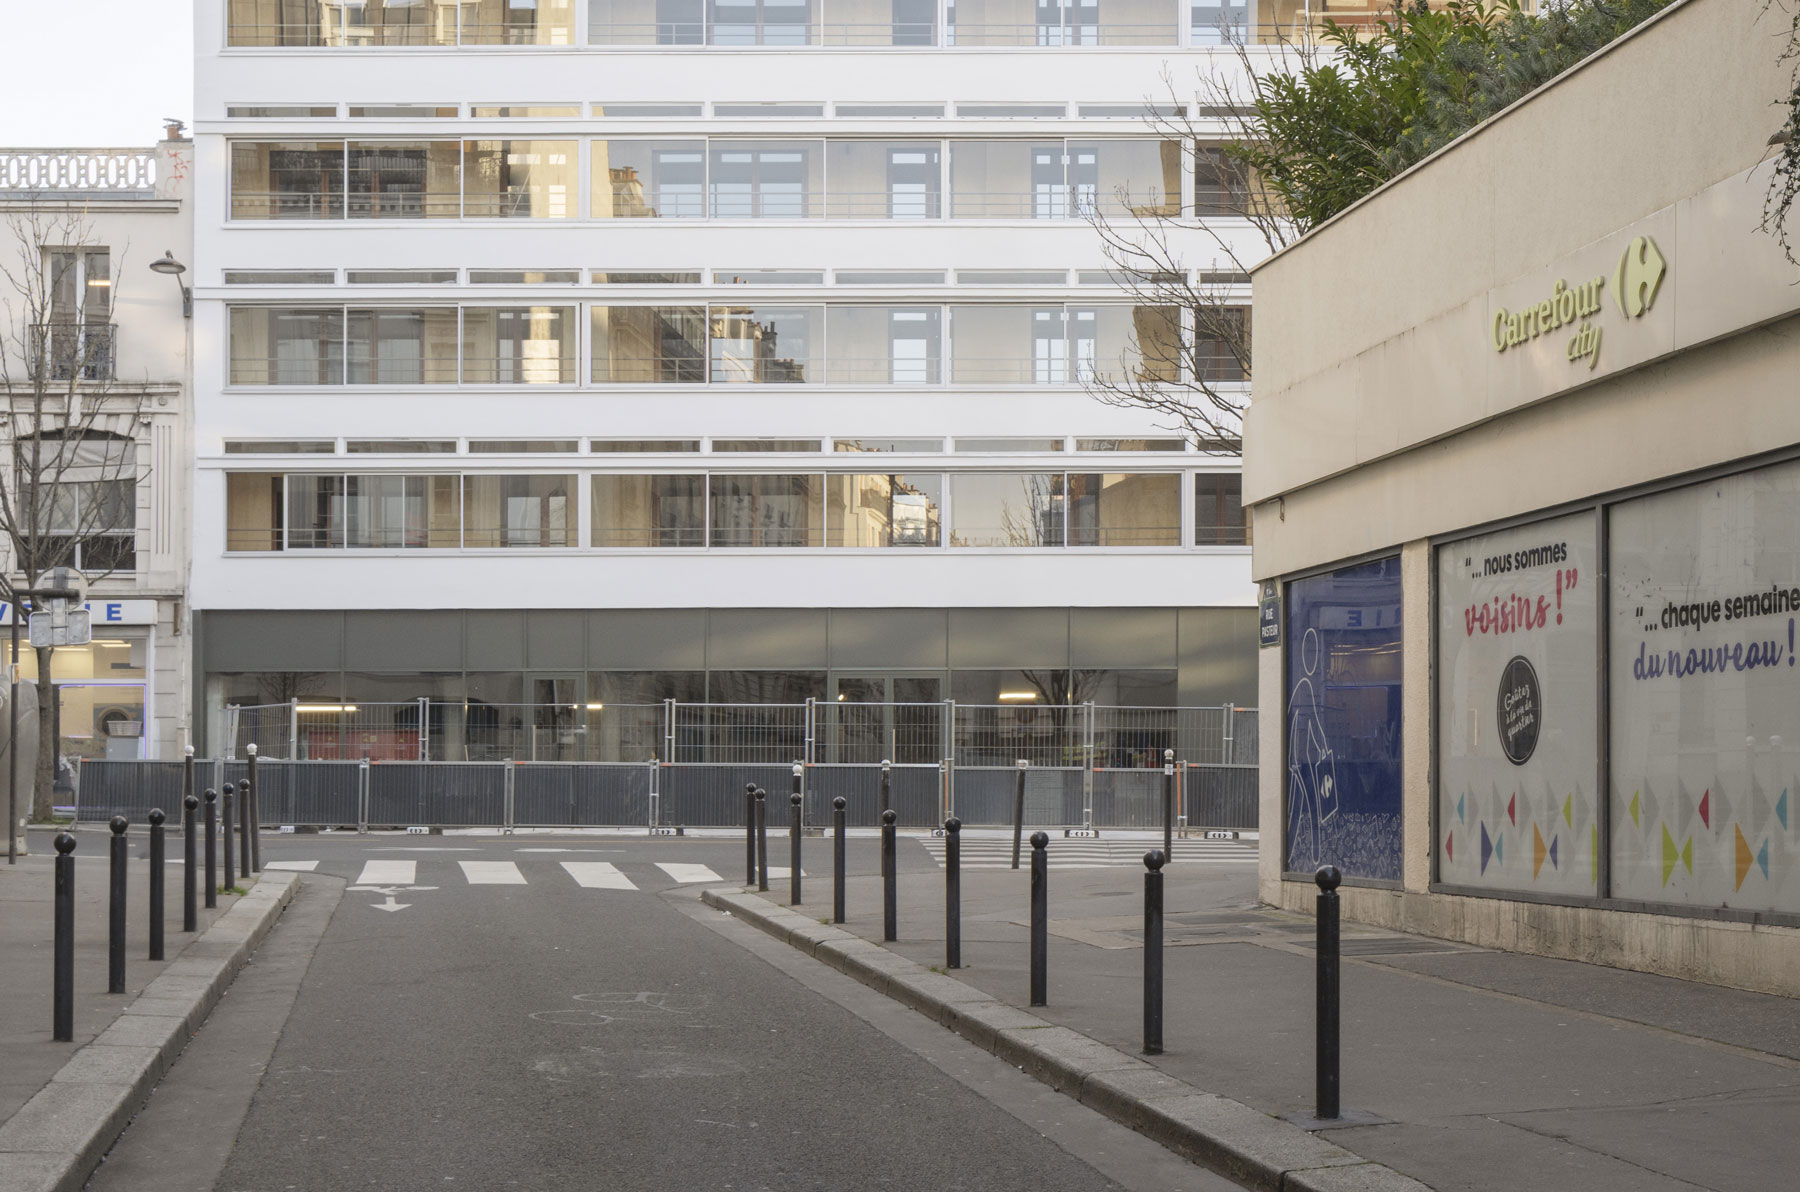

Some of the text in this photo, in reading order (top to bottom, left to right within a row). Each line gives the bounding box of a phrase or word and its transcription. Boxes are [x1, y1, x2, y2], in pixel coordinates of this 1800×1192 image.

[1493, 276, 1604, 352] Carrefour
[1566, 322, 1602, 371] city
[1484, 553, 1512, 576] nous
[1514, 542, 1567, 571] sommes
[1265, 608, 1274, 621] RUE
[1661, 600, 1722, 632] chaque
[1724, 584, 1800, 621] semaine
[1262, 624, 1278, 638] PASTEUR
[1633, 641, 1666, 681] du
[1668, 641, 1784, 679] nouveau
